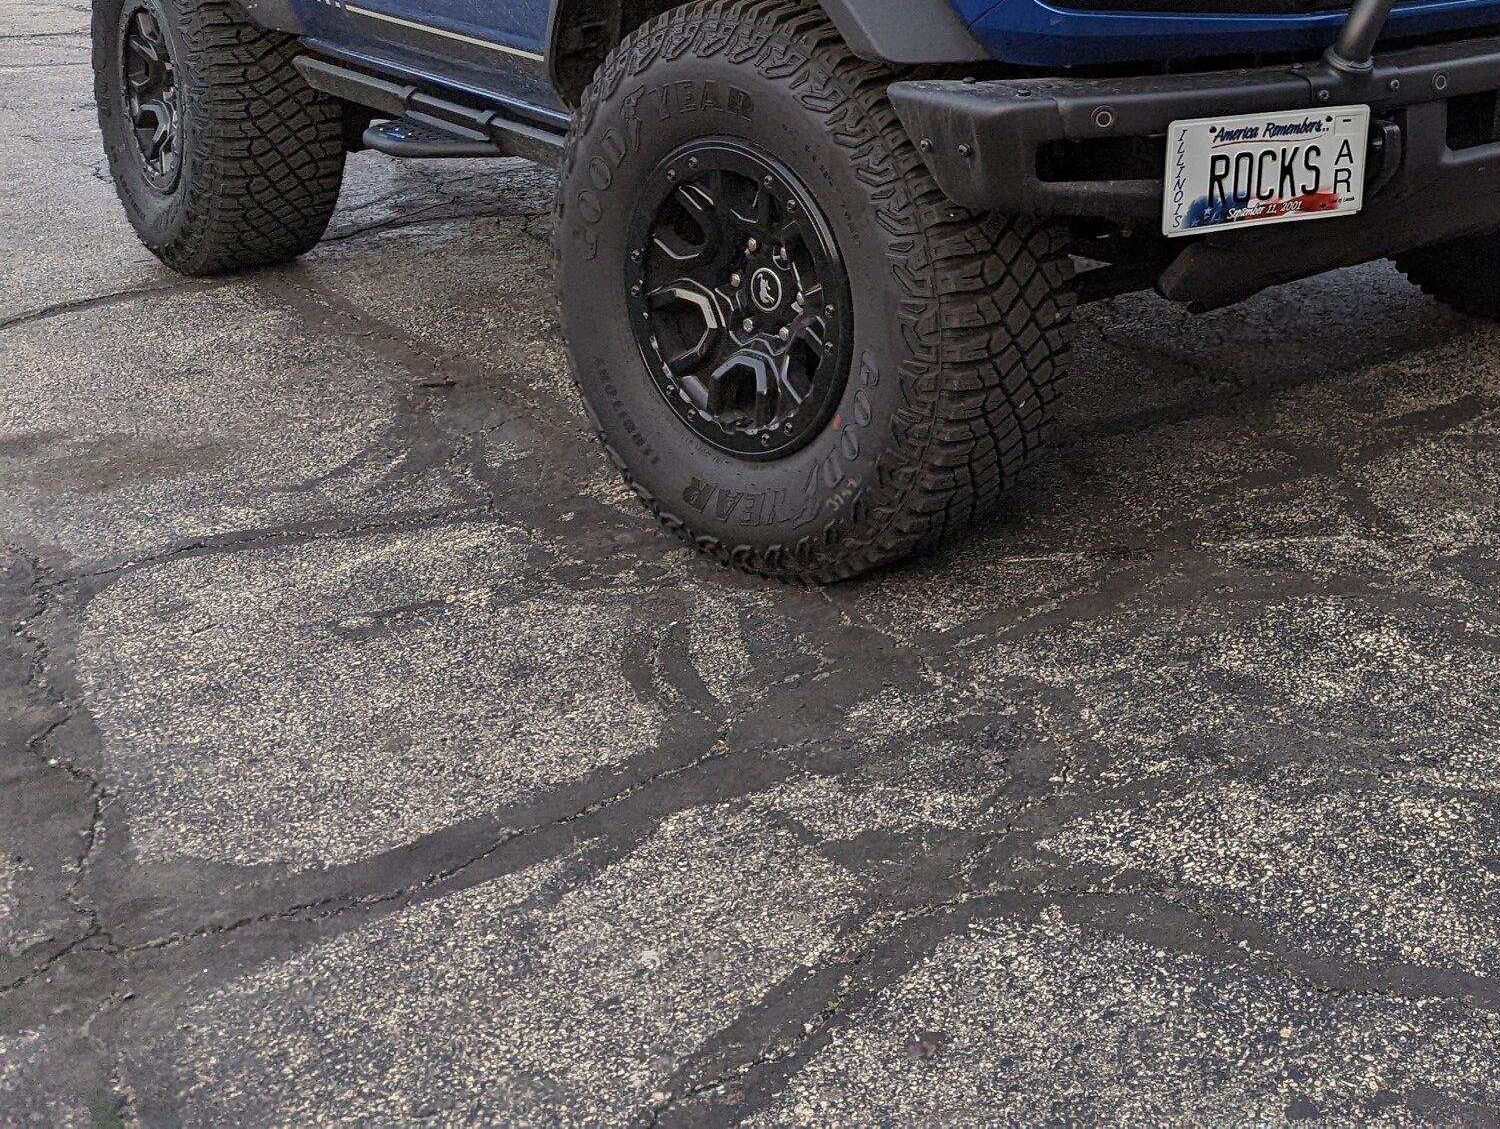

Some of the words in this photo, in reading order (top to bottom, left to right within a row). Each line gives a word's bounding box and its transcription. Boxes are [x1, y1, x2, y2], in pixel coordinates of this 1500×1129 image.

[1213, 126, 1260, 143] America
[1172, 129, 1188, 228] ILLINOIS
[1208, 145, 1321, 206] ROCKS
[1226, 202, 1265, 222] September
[1280, 200, 1303, 212] 2001
